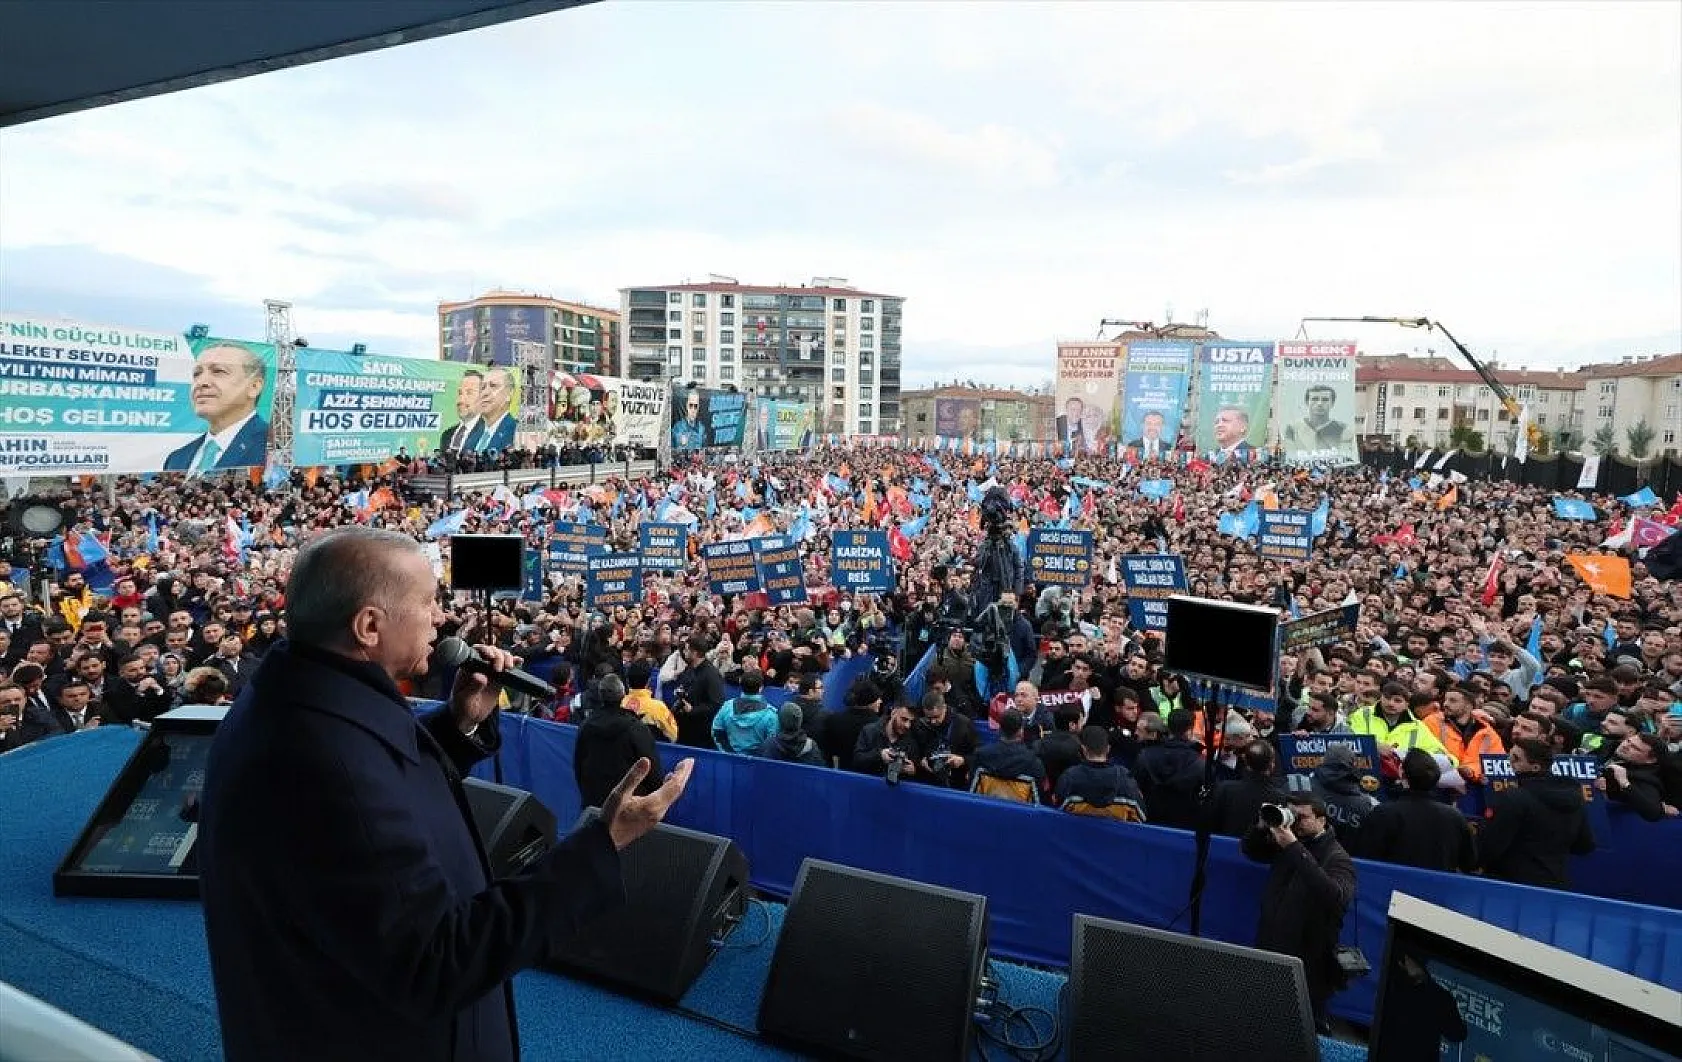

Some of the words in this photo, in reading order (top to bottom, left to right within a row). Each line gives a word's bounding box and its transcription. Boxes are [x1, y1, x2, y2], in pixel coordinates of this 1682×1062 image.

[53, 326, 120, 346] GÜÇLÜ
[67, 350, 158, 367] SEVDALISI
[1211, 347, 1264, 362] USTA
[322, 391, 358, 408] AZİZ
[308, 412, 352, 430] HOŞ
[361, 413, 439, 429] GELDİNİZ
[853, 534, 866, 545] BU
[837, 546, 882, 557] KARİZMA
[849, 571, 870, 582] REİS
[1551, 758, 1597, 778] ATİLE
